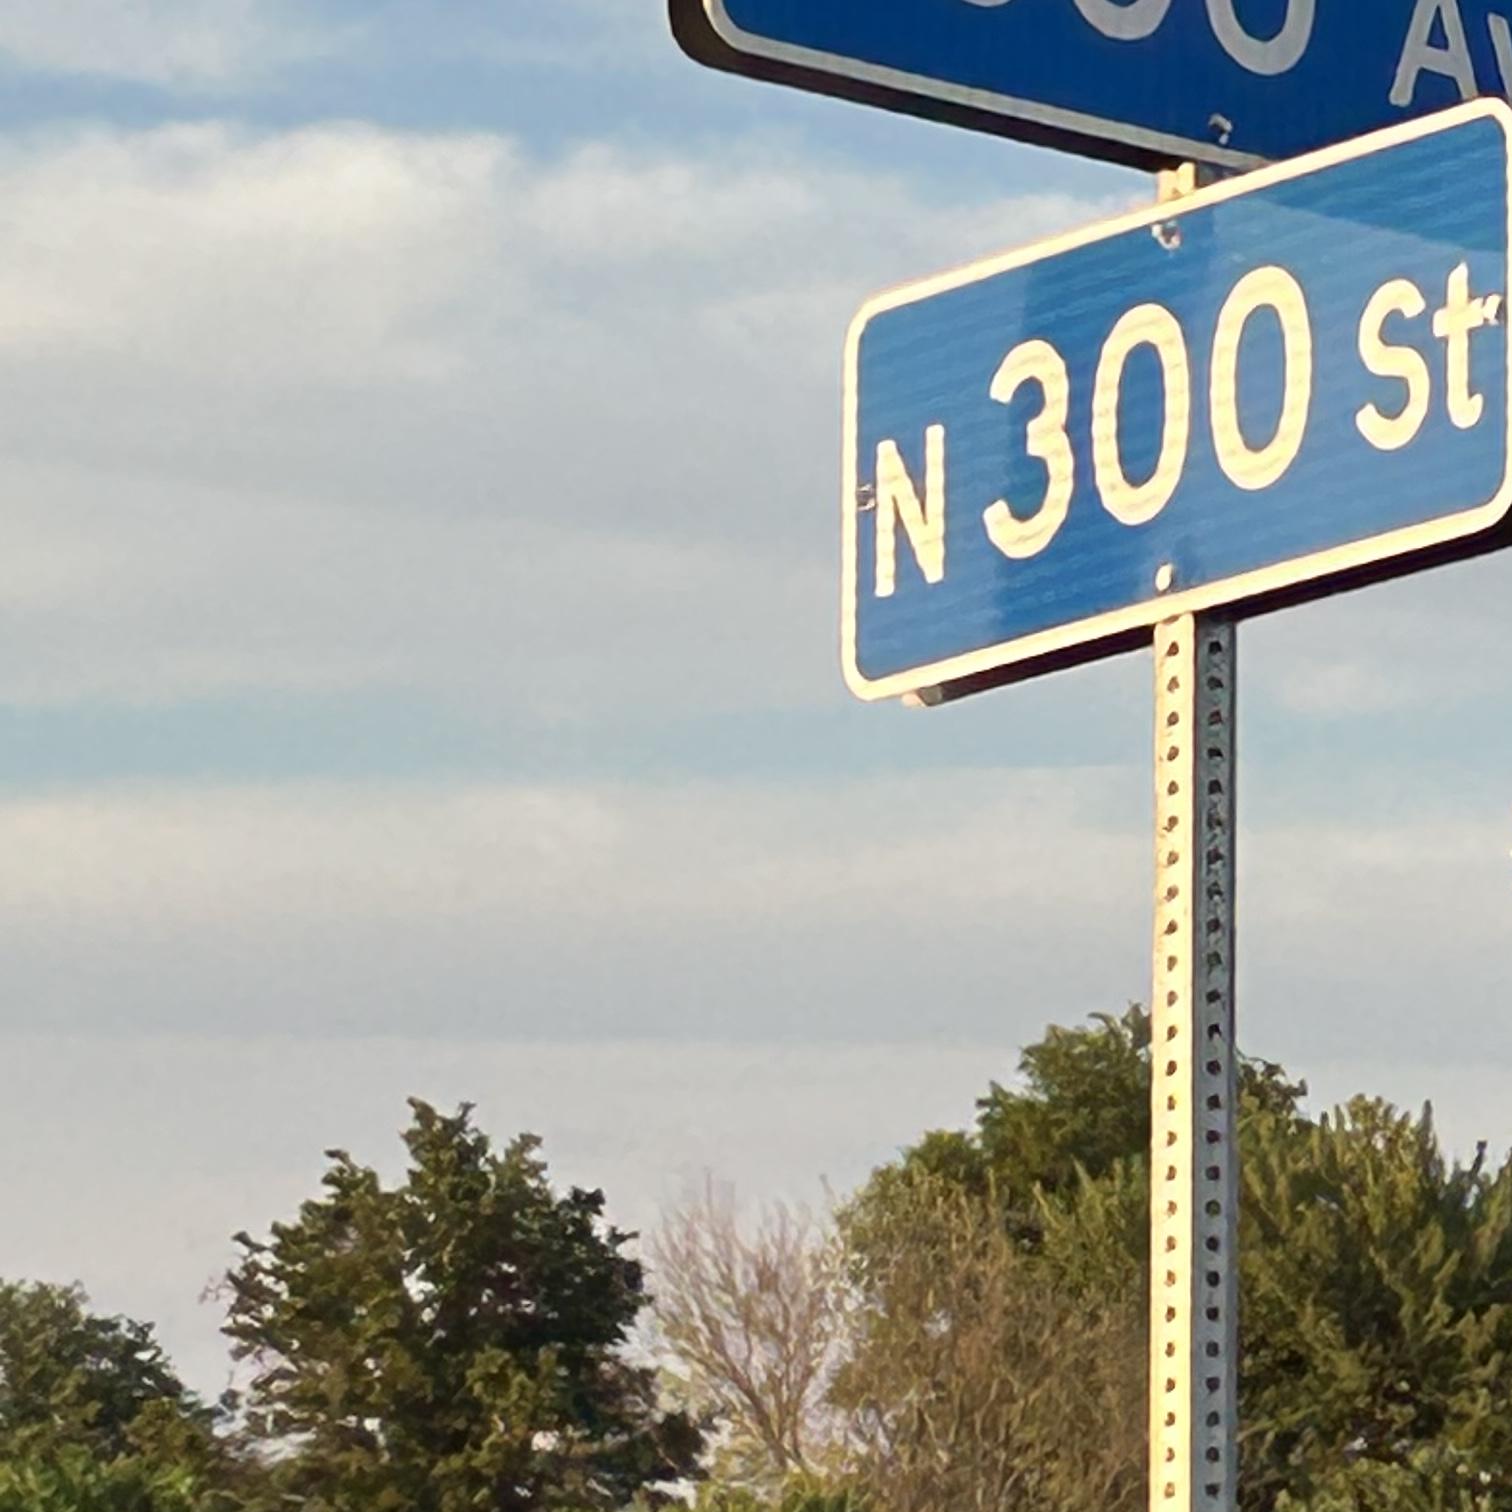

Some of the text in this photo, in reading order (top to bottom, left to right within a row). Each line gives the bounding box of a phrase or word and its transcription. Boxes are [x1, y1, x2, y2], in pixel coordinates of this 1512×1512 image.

[874, 262, 1494, 598] N 300 St
